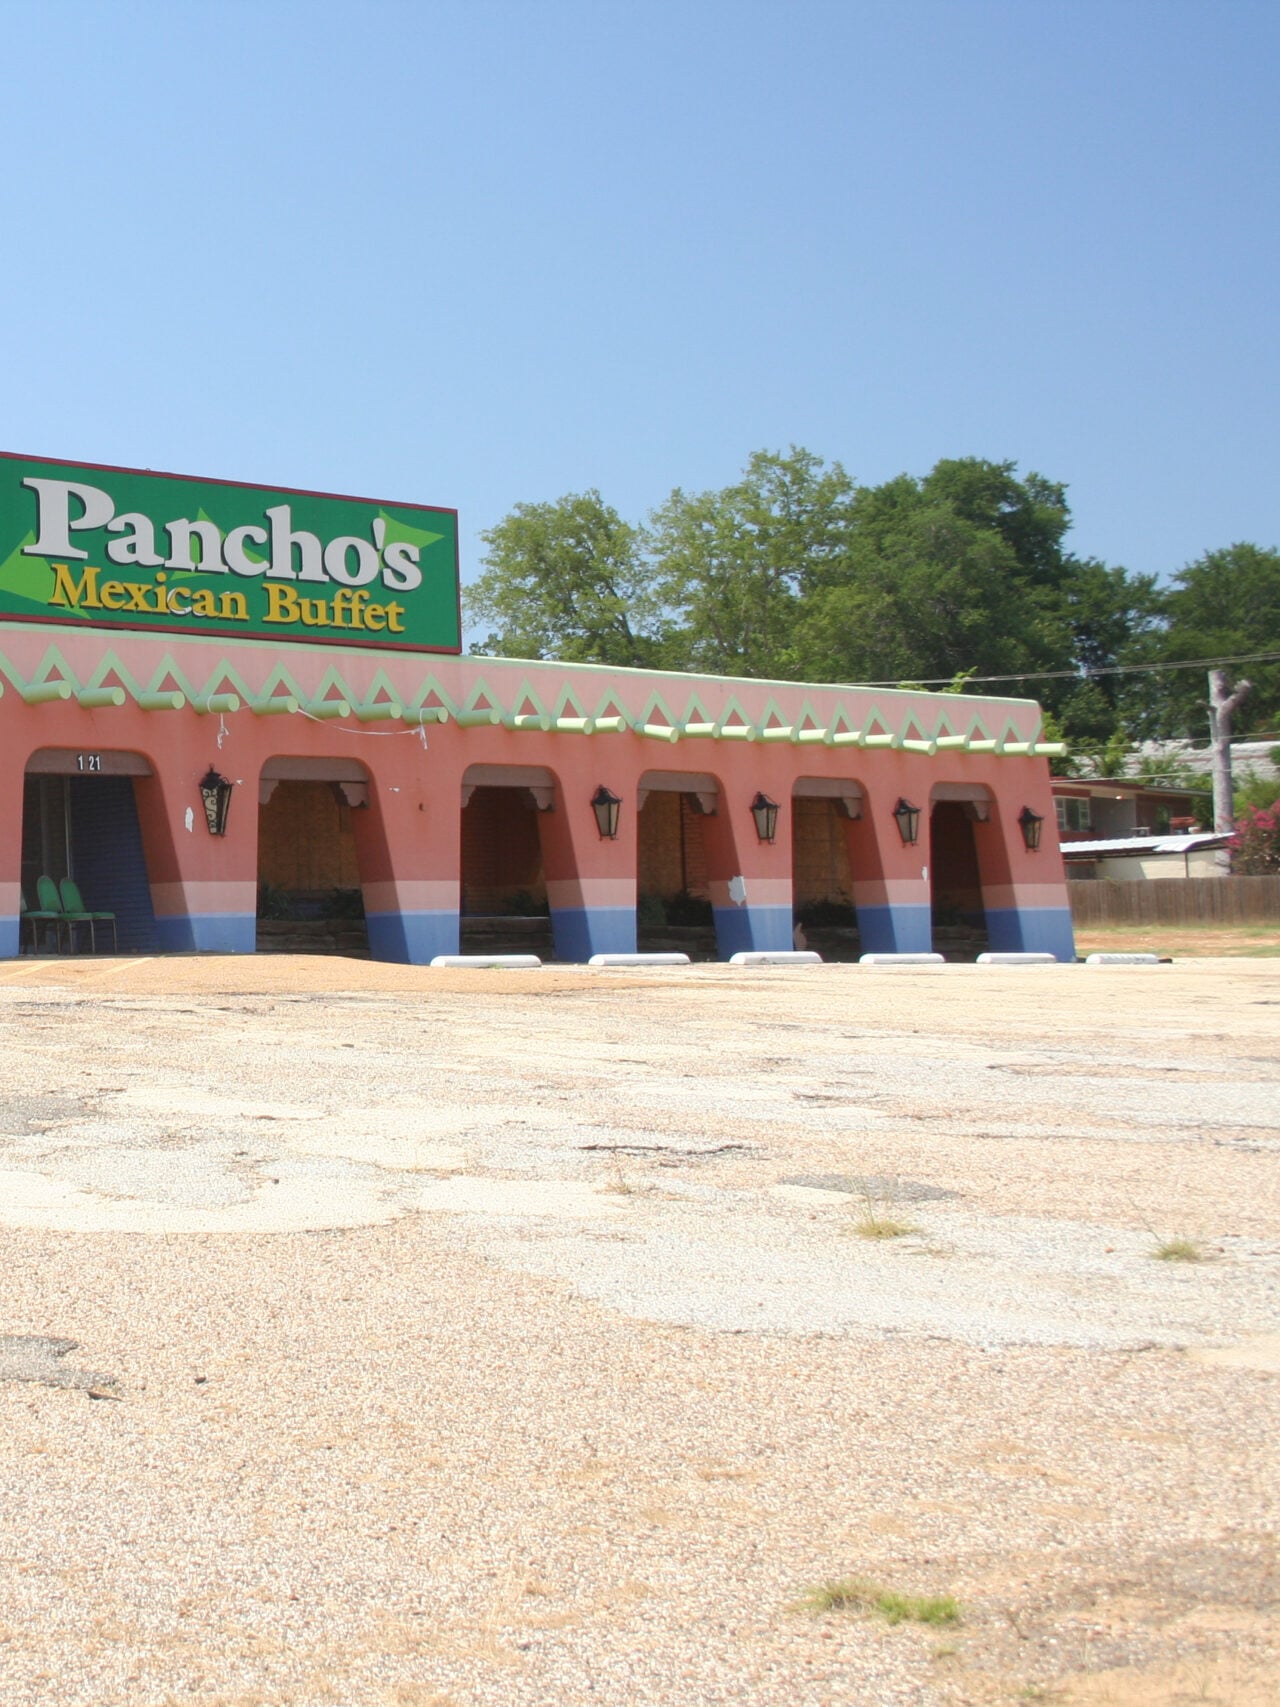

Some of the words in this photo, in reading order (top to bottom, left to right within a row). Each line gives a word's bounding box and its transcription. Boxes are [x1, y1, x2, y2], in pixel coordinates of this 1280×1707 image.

[23, 477, 422, 592] Pancho's
[48, 563, 249, 621] Mexican
[262, 583, 405, 632] Buffet
